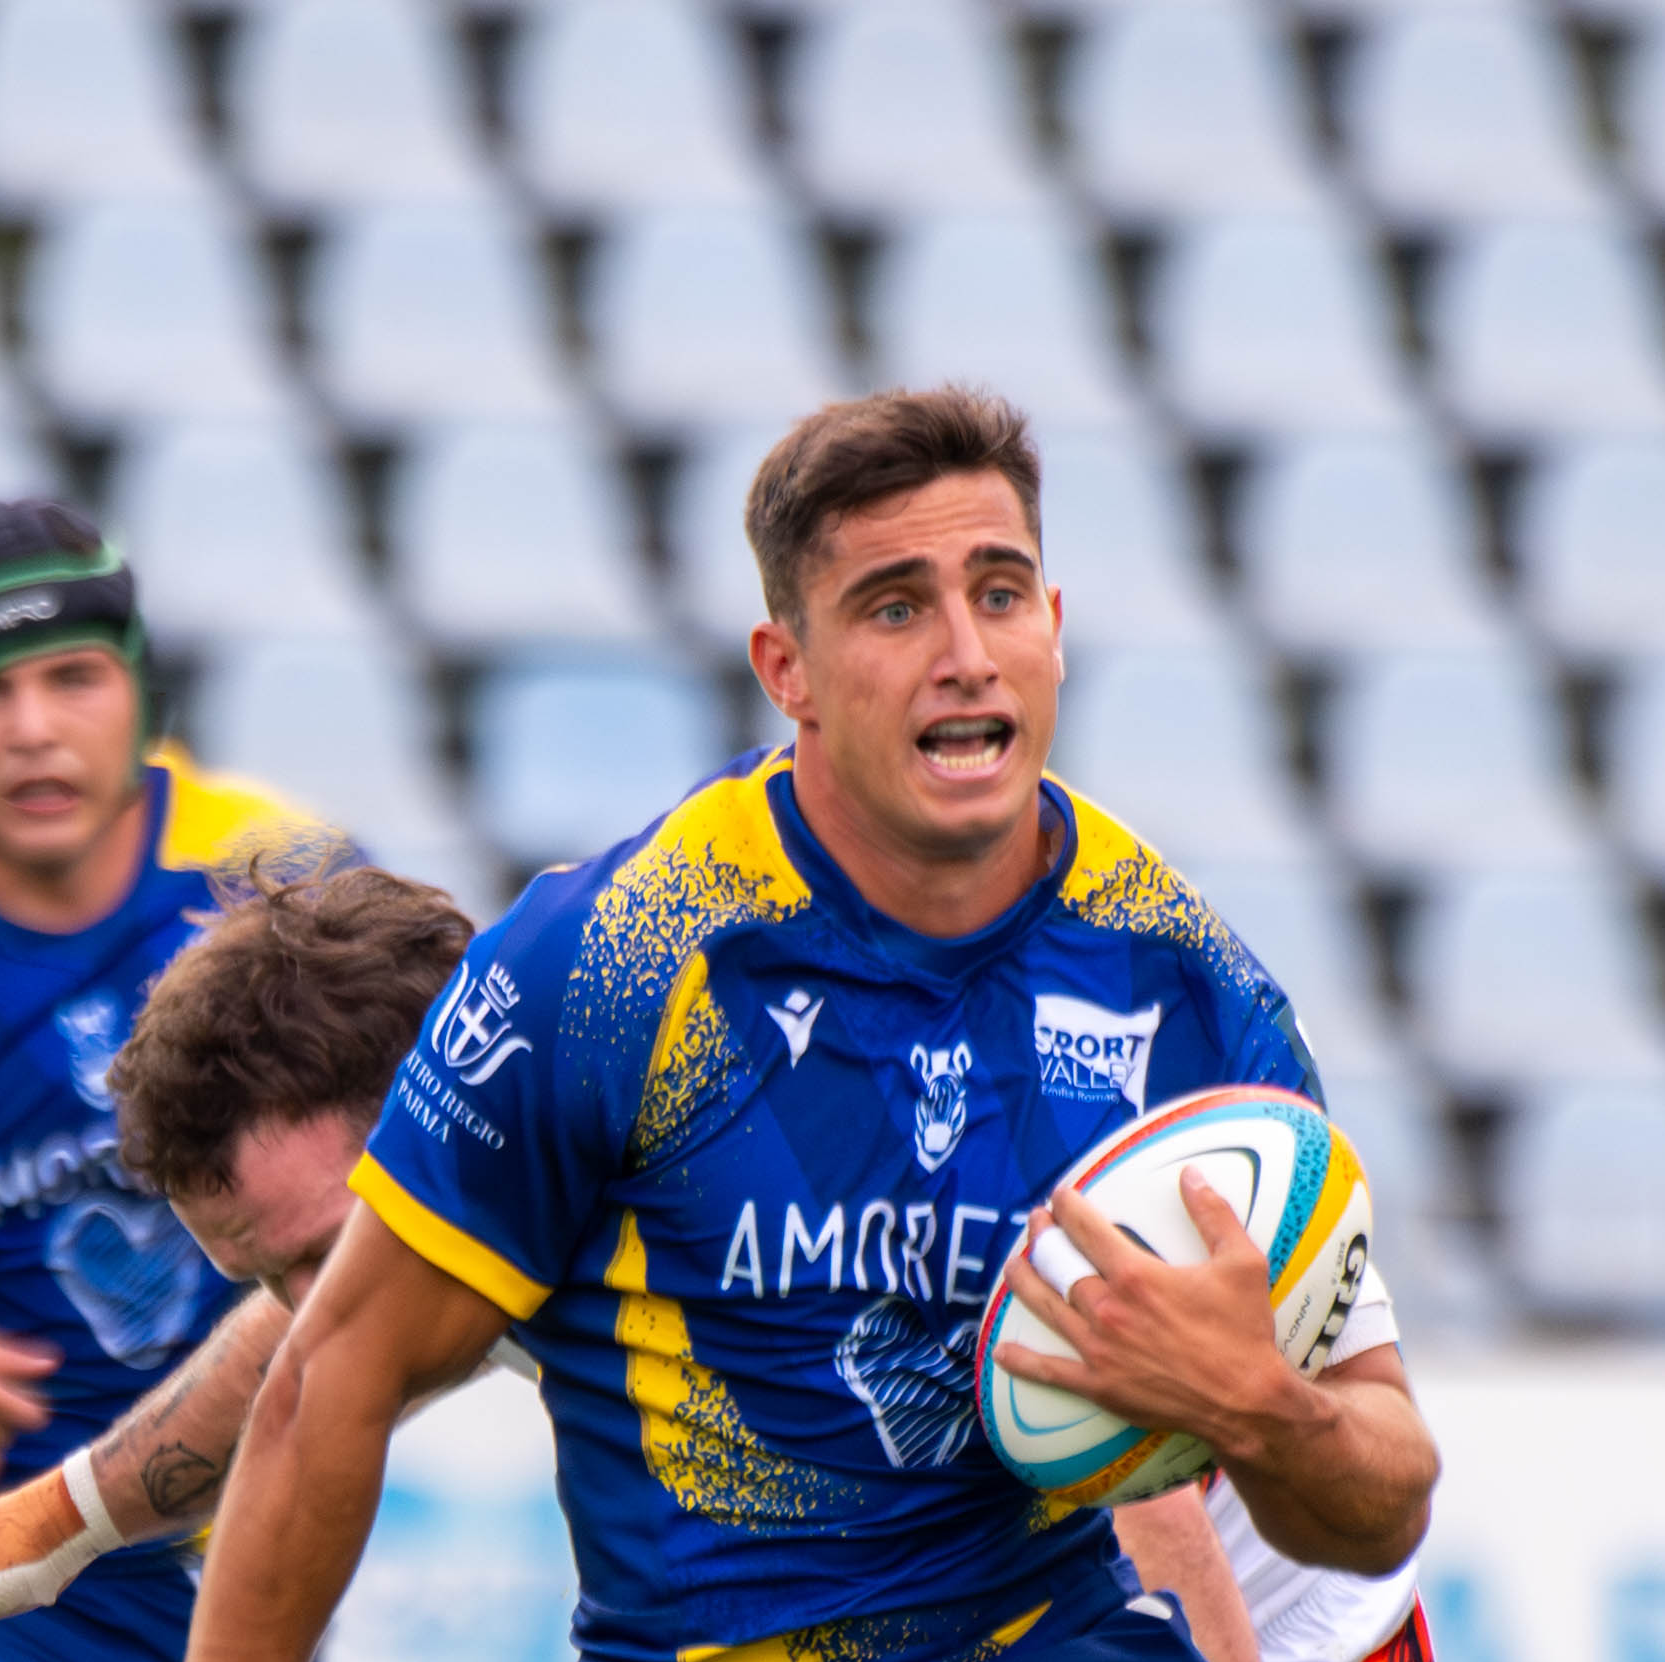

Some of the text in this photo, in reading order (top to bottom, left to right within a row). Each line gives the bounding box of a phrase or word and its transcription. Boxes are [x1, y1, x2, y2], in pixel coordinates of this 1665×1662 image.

[1034, 1024, 1145, 1062] SPORT
[397, 1076, 450, 1145] PARMA
[404, 1048, 505, 1150] ATRO REGIO
[721, 1198, 1029, 1303] AMORE
[1299, 1233, 1367, 1370] GIL
